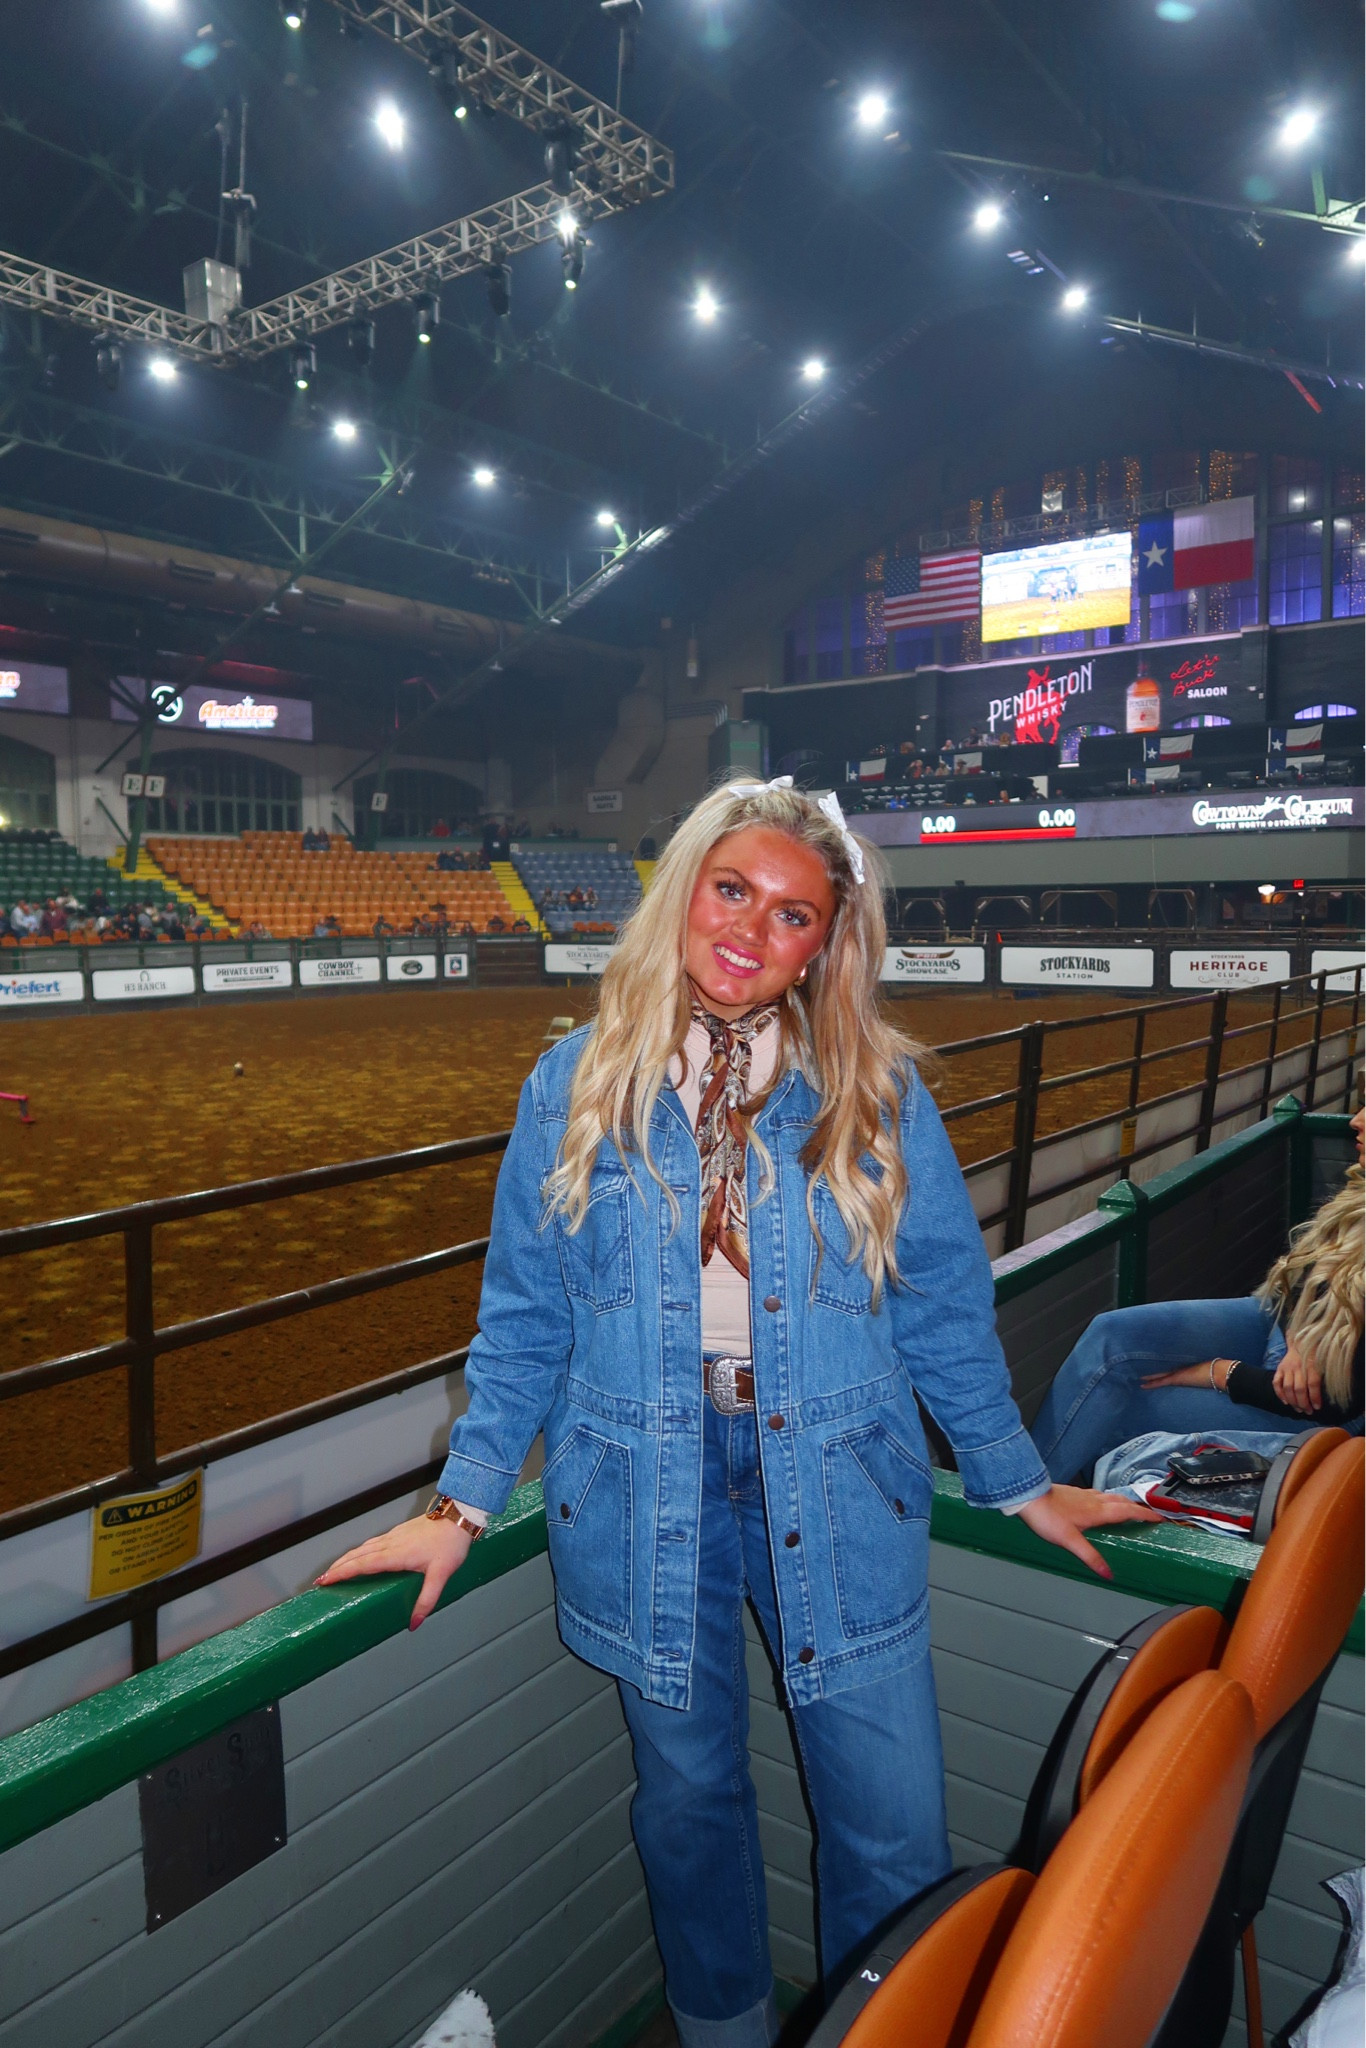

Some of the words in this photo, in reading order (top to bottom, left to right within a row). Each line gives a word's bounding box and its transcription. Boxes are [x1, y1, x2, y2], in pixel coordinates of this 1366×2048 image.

[1173, 669, 1216, 697] Buck
[987, 661, 1093, 732] PENDLETON
[1187, 686, 1228, 699] SALOON
[1016, 700, 1067, 729] WHISKY
[150, 779, 162, 791] F
[1039, 809, 1076, 828] 0.00
[1192, 801, 1262, 826] COWTOWN
[922, 817, 956, 834] 0.00
[1238, 821, 1266, 829] WORTH
[216, 967, 248, 976] PRIVATE
[249, 965, 279, 975] EVENTS
[318, 961, 354, 970] COWBOY
[895, 958, 961, 971] STOCKYARDS
[1040, 955, 1111, 973] STOCKYARDS
[1190, 961, 1268, 972] HERITAGE
[318, 969, 355, 977] CHANNEL
[137, 982, 166, 991] RANCH
[127, 1484, 195, 1518] WARNING
[860, 1969, 881, 1982] 2
